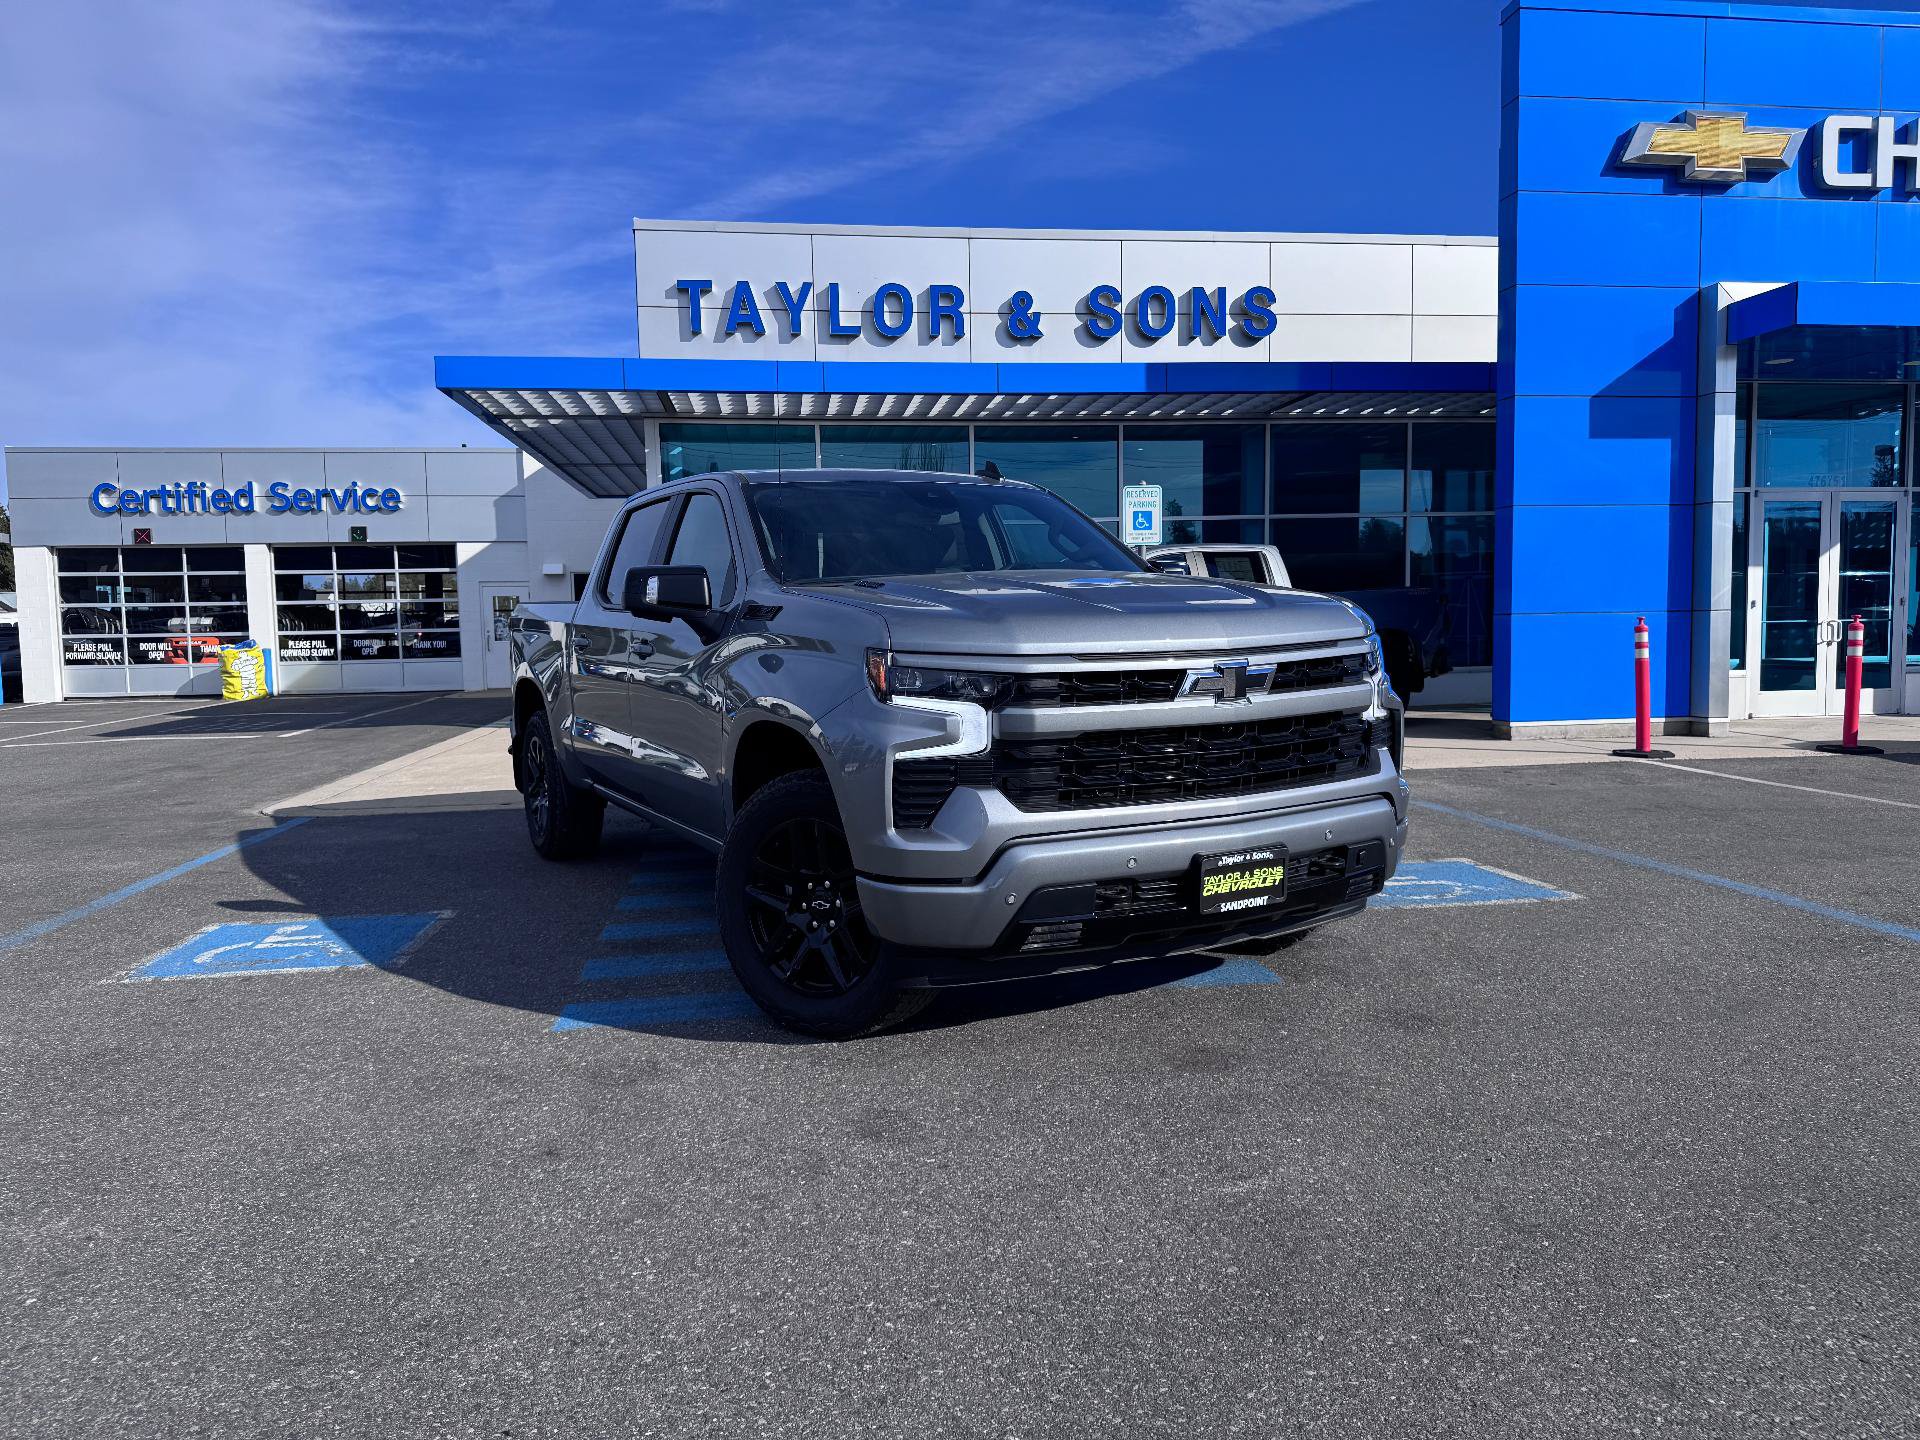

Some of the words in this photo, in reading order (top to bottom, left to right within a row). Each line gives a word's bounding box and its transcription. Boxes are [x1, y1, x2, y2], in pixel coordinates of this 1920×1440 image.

[676, 279, 966, 338] TAYLOR
[1007, 290, 1044, 337] &
[1087, 284, 1277, 338] SONS
[93, 481, 254, 513] Certified
[269, 481, 401, 512] Service
[1126, 490, 1158, 498] RESERVED
[1128, 500, 1157, 509] PARKING
[73, 643, 97, 652] PLEASE
[97, 643, 114, 652] PULL
[140, 642, 158, 651] DOOR
[157, 642, 173, 651] WILL
[288, 640, 311, 648] PLEASE
[311, 640, 327, 648] PULL
[353, 639, 371, 648] DOOR
[412, 640, 432, 649] THANK
[432, 640, 447, 649] YOU!
[65, 652, 96, 660] FORWARD
[96, 652, 122, 660] SLOWLY
[148, 651, 165, 660] OPEN
[280, 648, 310, 657] FORWARD
[311, 648, 335, 657] SLOWLY
[361, 647, 378, 656] OPEN
[1221, 854, 1245, 866] Taylor
[1252, 851, 1270, 860] Sons
[1203, 872, 1241, 885] TAYLOR
[1244, 871, 1251, 880] &
[1253, 866, 1284, 877] SONS
[1202, 876, 1284, 897] CHEVROLET
[1220, 895, 1269, 913] SANDPOINT
